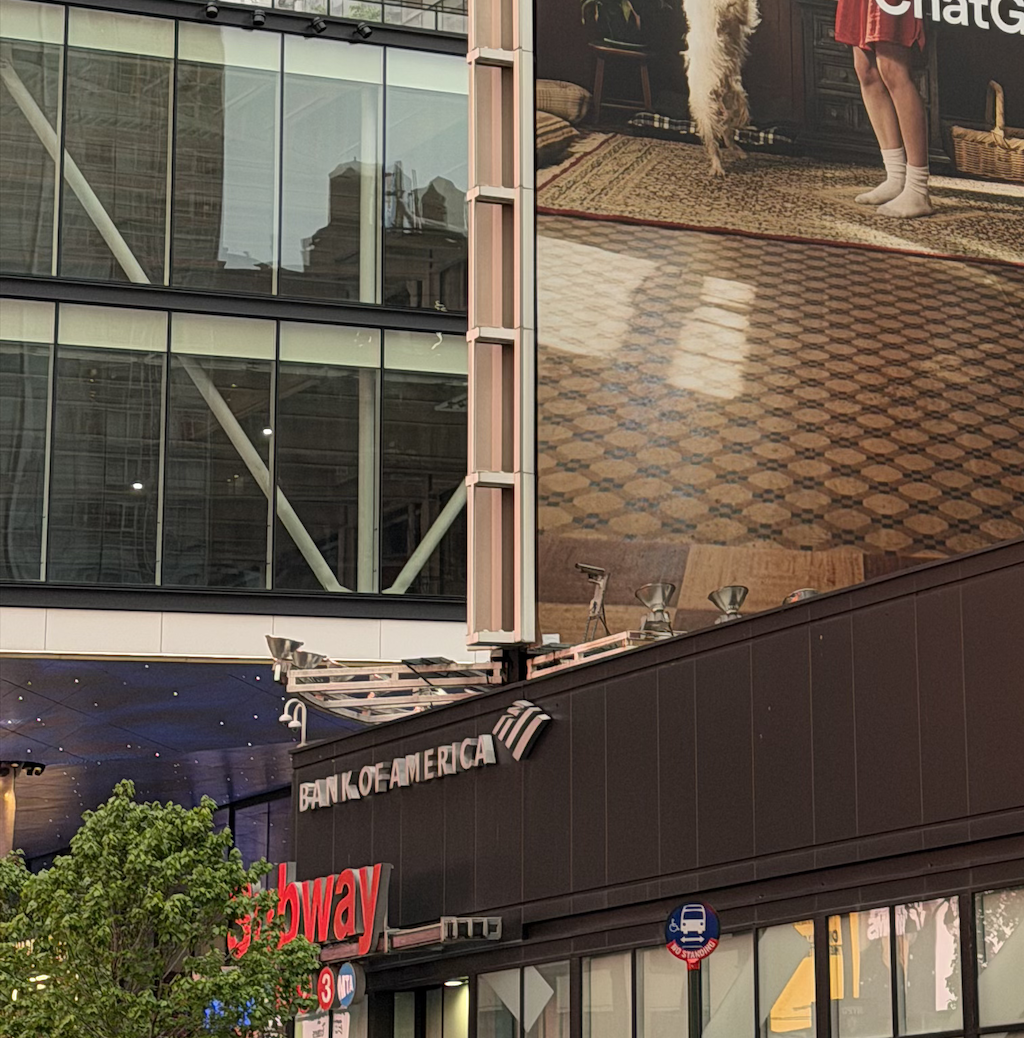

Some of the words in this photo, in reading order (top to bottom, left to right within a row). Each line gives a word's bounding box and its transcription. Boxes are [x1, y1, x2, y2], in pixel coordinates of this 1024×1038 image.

[299, 770, 360, 812] BANK
[358, 762, 384, 797] OF
[389, 735, 495, 790] AMERICA
[227, 862, 383, 960] sbway
[670, 942, 682, 955] NO
[681, 941, 716, 959] STANDING
[321, 973, 332, 1004] 3
